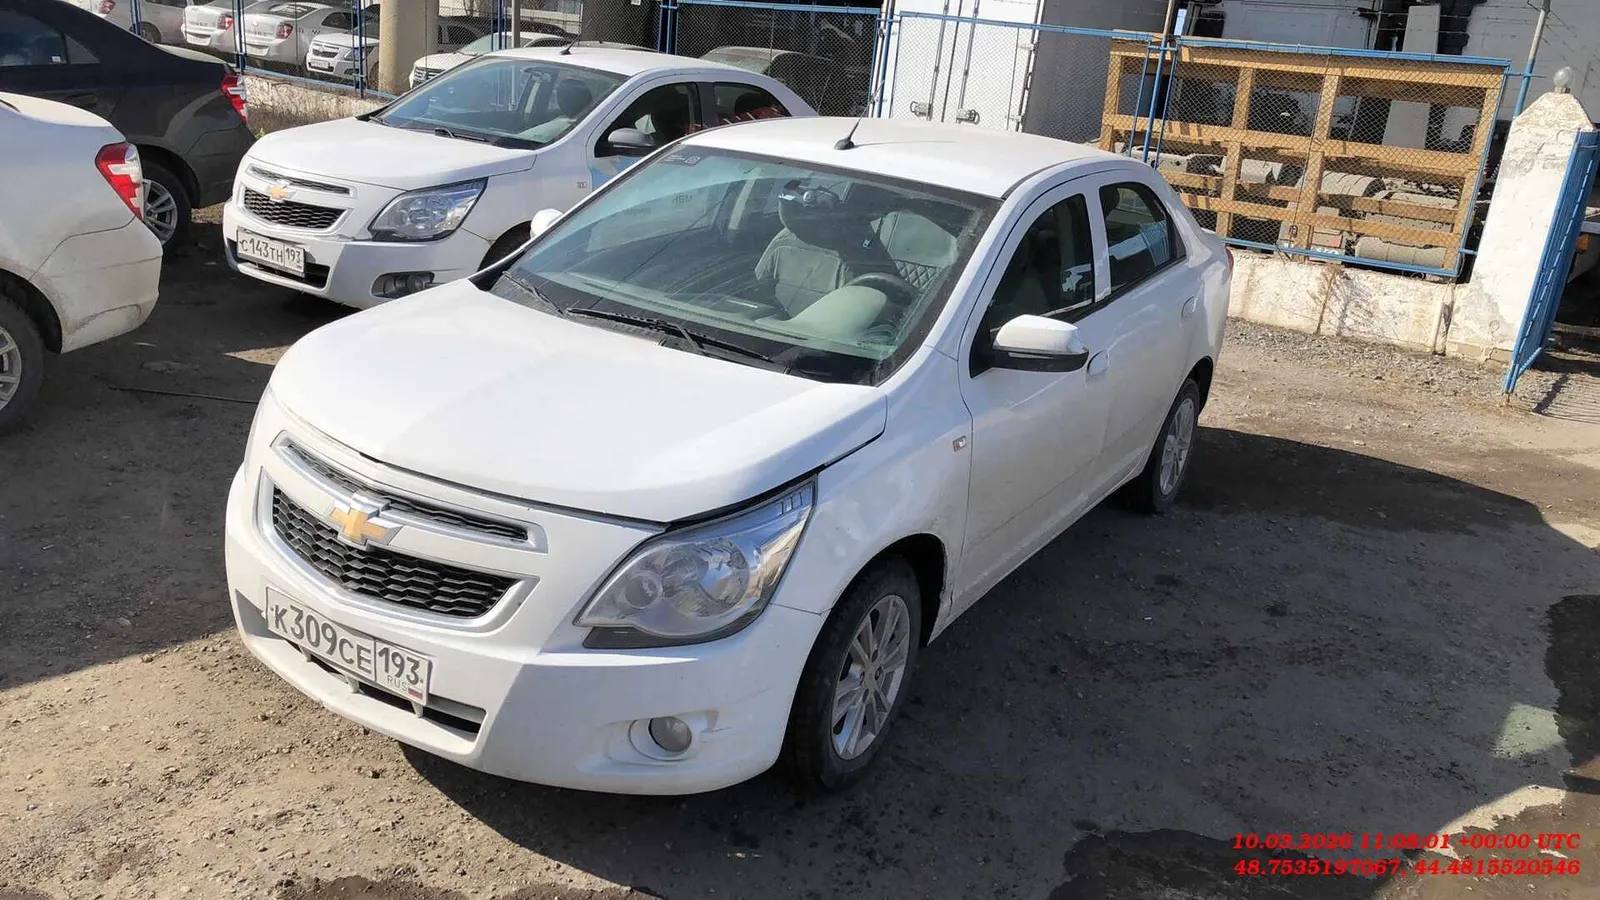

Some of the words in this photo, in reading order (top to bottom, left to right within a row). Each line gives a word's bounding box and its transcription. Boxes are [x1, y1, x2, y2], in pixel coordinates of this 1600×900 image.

[285, 247, 301, 263] 193
[274, 604, 372, 674] К309СЕ
[378, 646, 420, 685] 193
[387, 674, 409, 692] RUS
